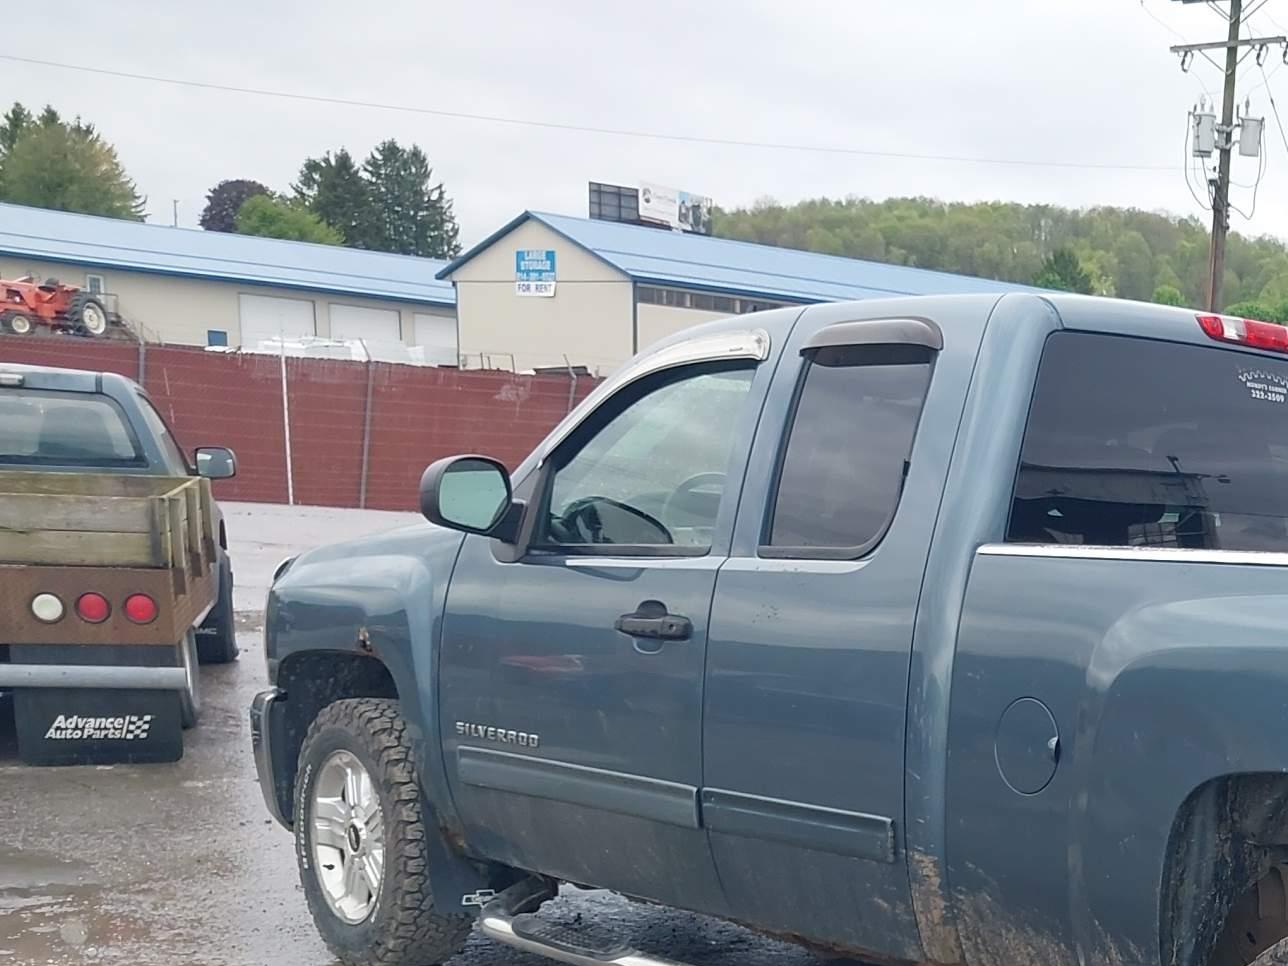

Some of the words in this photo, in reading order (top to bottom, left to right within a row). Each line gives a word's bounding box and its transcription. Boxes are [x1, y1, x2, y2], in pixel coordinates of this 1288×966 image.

[517, 283, 531, 293] FOR
[535, 283, 553, 293] RENT
[52, 714, 124, 729] Advance
[44, 728, 82, 739] Auto
[82, 728, 122, 739] Parts
[456, 721, 540, 748] SILVERADO
